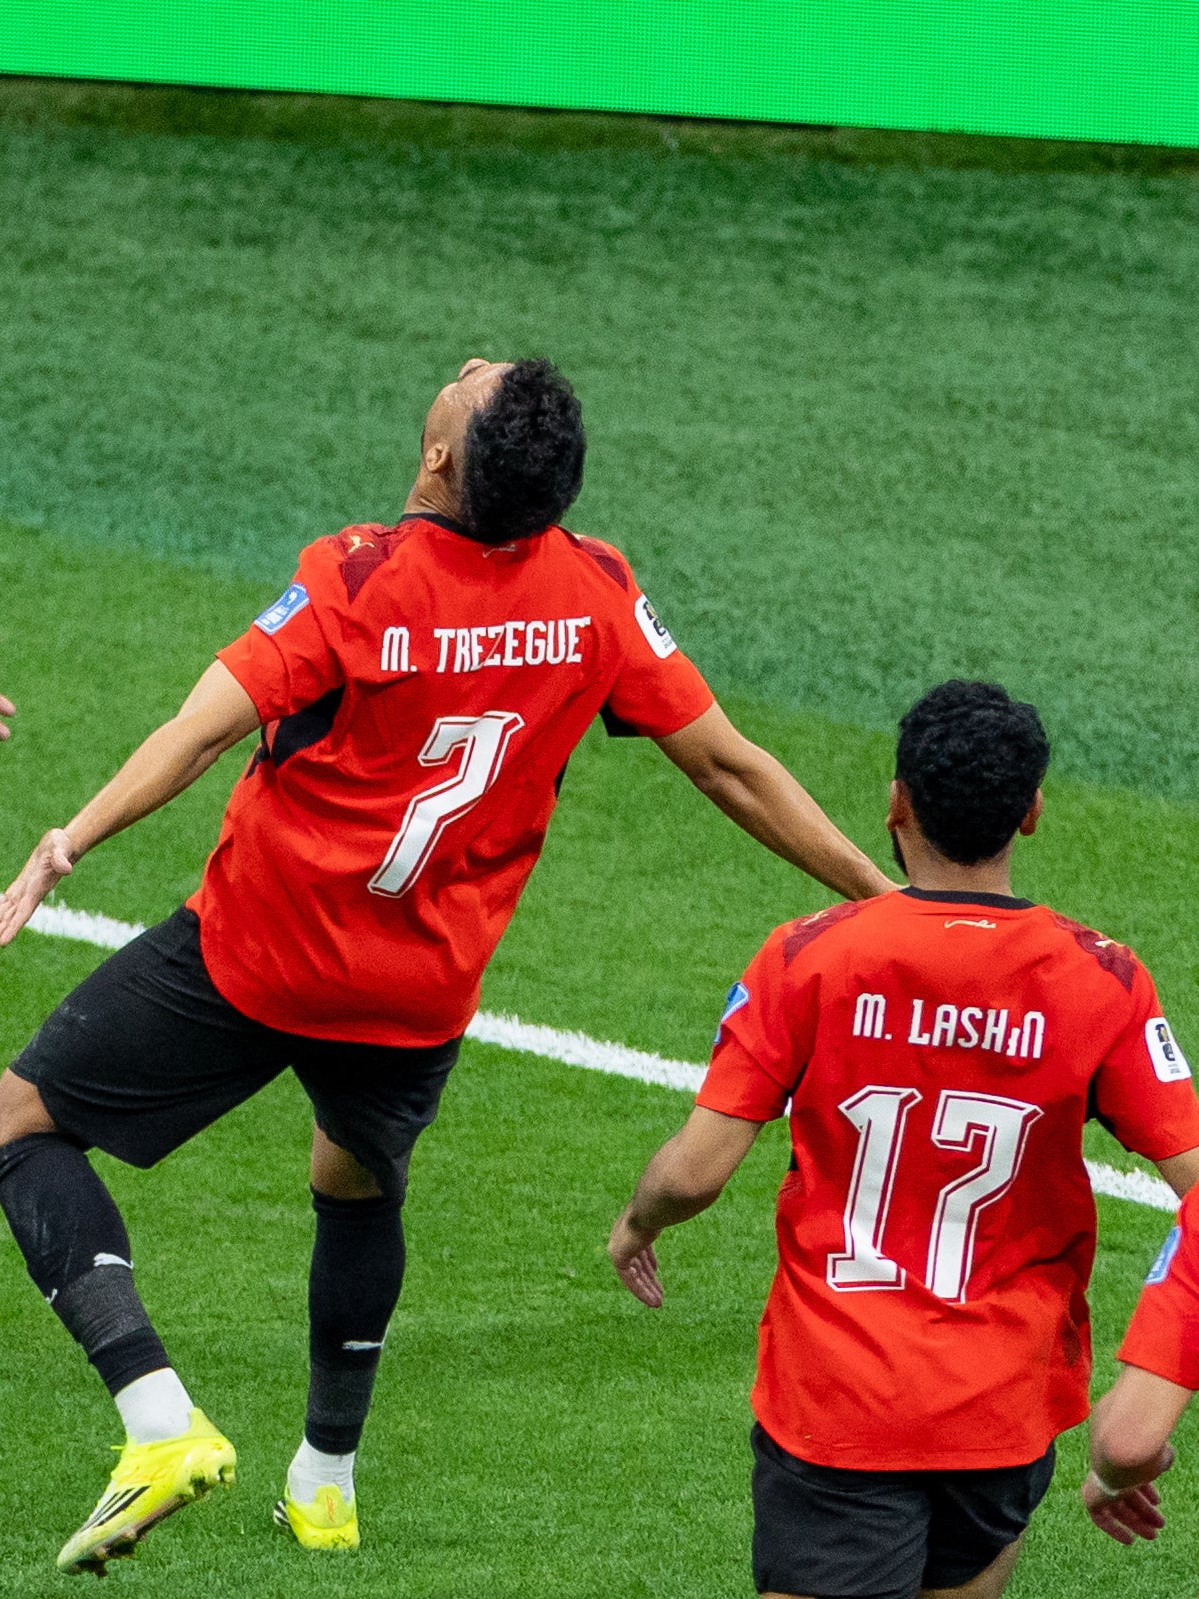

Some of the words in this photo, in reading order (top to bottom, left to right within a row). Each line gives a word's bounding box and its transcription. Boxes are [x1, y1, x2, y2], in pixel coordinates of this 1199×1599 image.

[380, 626, 418, 672] M.
[433, 616, 591, 673] TREZEGUE
[367, 710, 525, 898] 7
[852, 992, 893, 1041] M.
[826, 1085, 1045, 1305] 17
